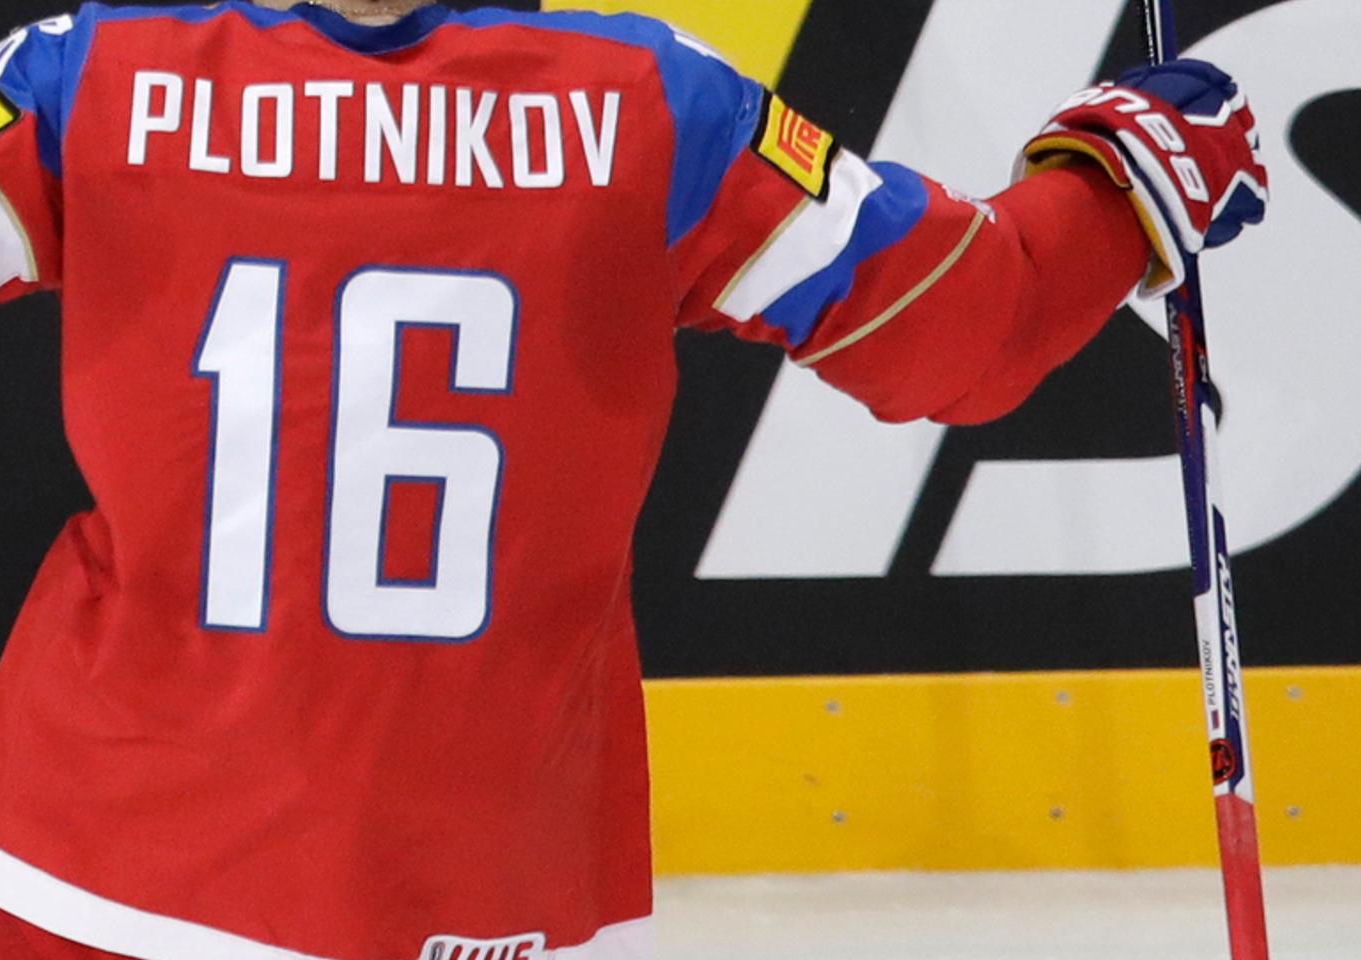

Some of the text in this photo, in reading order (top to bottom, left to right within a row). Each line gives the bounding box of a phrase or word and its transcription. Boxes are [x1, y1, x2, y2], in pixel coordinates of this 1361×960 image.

[126, 70, 619, 189] PLOTNIKOV
[190, 254, 520, 643] 16
[1205, 639, 1216, 707] PLOTNIKOV
